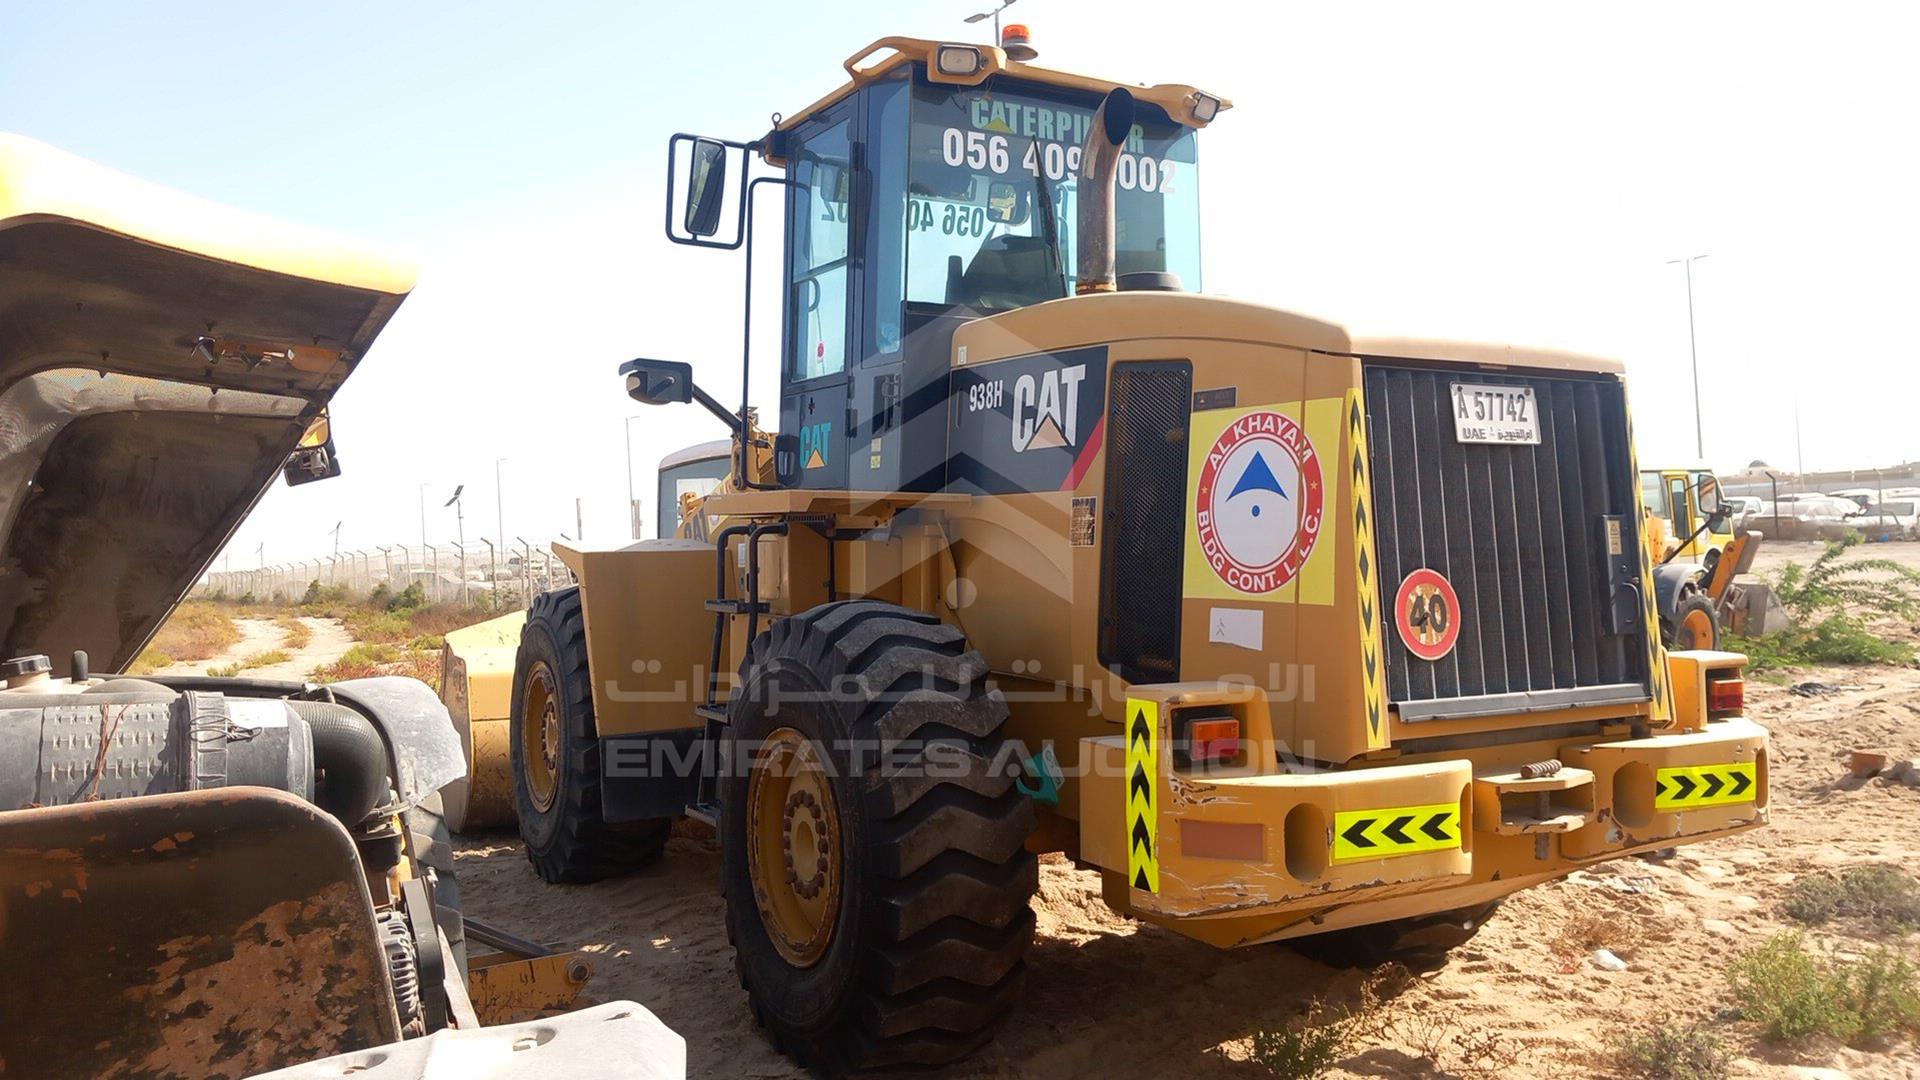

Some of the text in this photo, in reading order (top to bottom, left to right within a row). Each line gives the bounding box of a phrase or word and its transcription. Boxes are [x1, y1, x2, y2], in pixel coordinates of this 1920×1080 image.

[971, 99, 1145, 155] CATERPIR
[942, 127, 1177, 195] 056 409 002
[969, 379, 1004, 412] 938H
[1012, 363, 1086, 453] CAT
[1457, 389, 1528, 422] A 57742
[800, 422, 832, 469] CAT
[1208, 415, 1315, 471] AL KHAYAM
[1462, 427, 1487, 440] UAE
[1197, 510, 1226, 573] BLDG
[1226, 567, 1282, 591] CONT.
[1409, 594, 1447, 634] 40
